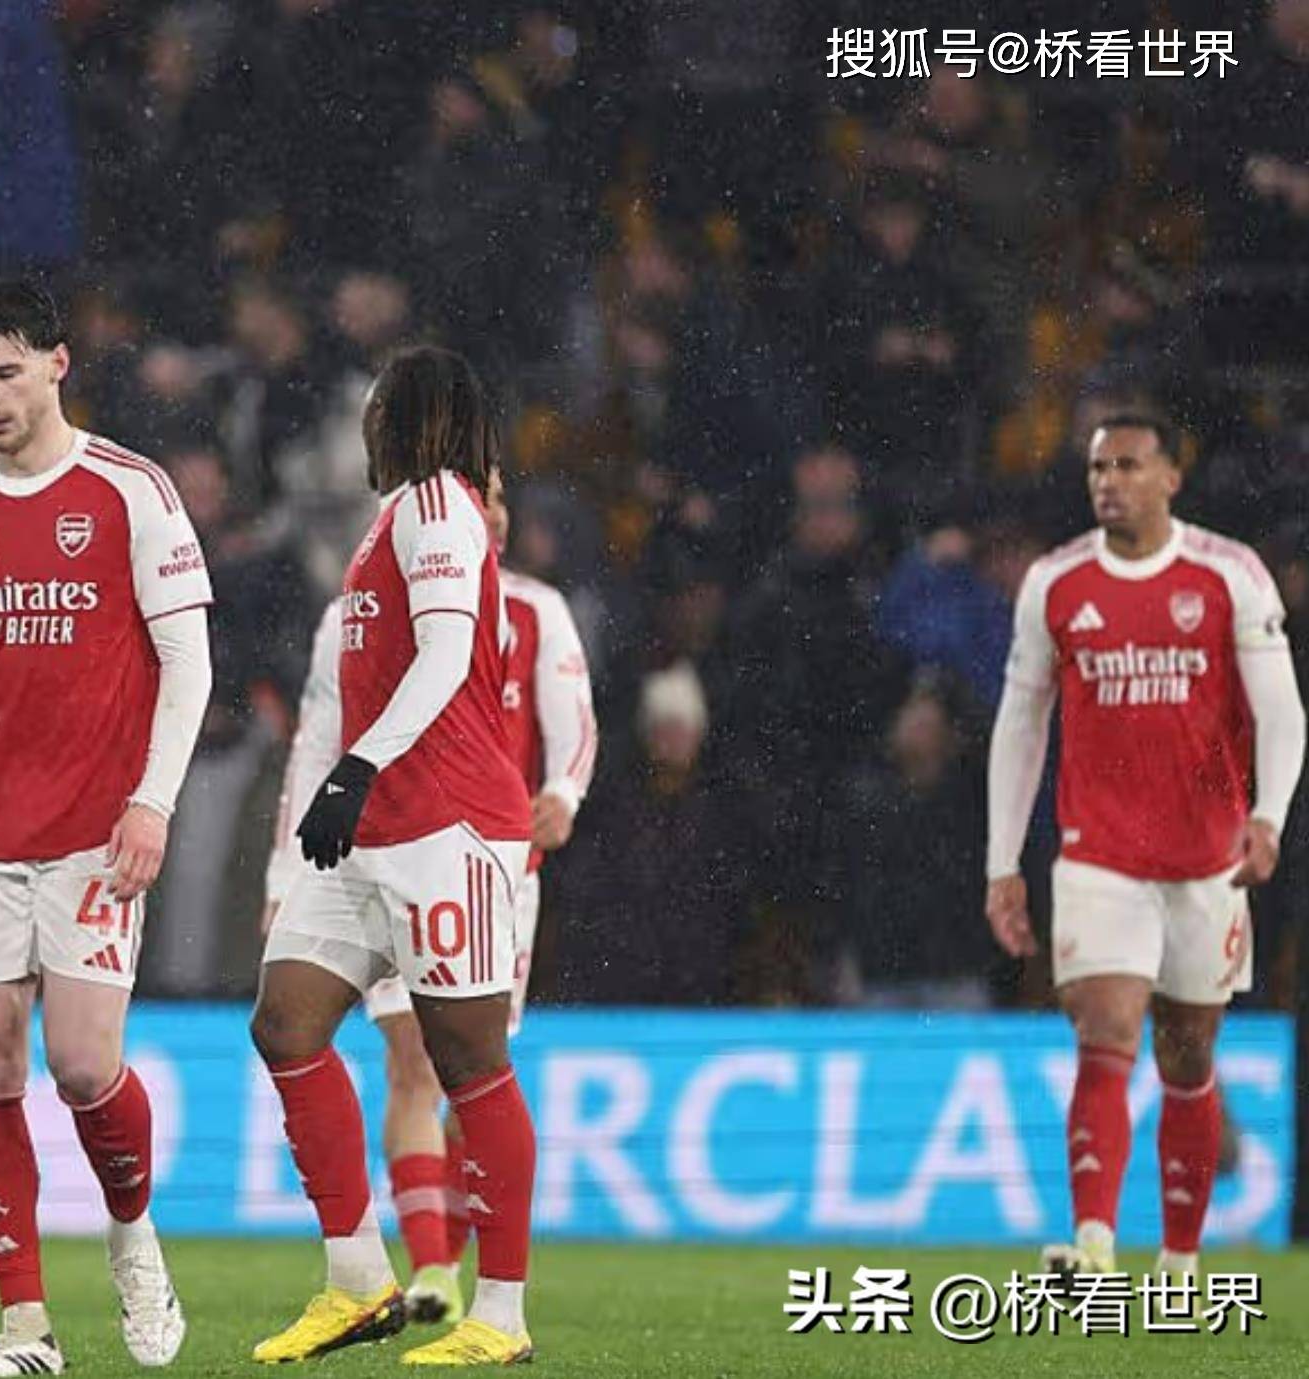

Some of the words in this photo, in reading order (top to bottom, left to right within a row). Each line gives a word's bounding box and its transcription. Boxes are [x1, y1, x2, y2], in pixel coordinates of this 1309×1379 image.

[5, 615, 74, 645] BETTER
[1076, 641, 1209, 682] Emirates
[76, 876, 132, 939] 41
[405, 900, 467, 958] 10
